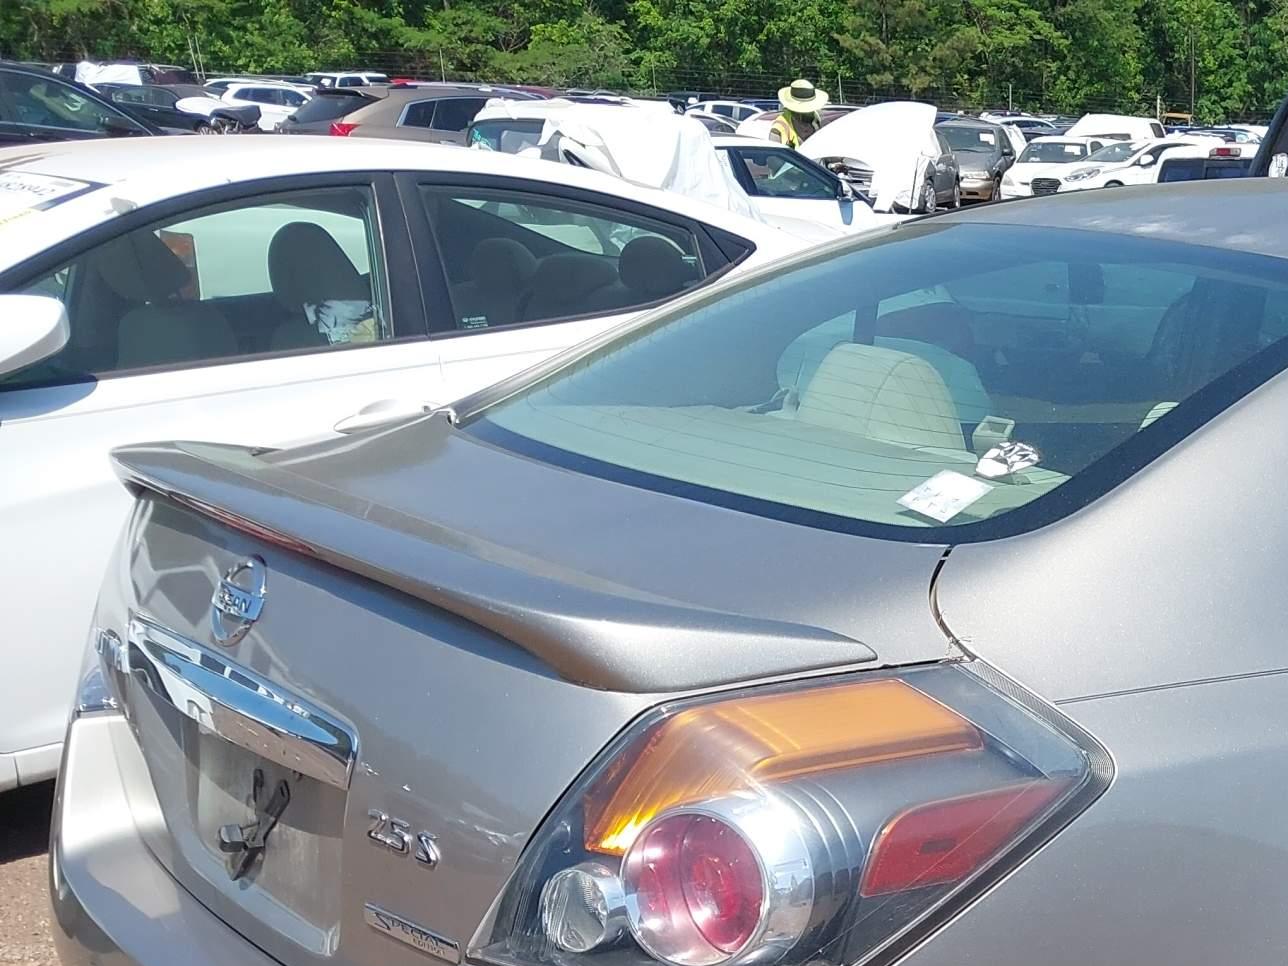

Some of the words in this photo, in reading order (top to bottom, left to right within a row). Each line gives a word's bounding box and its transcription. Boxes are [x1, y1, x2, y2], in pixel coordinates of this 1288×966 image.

[415, 831, 440, 865] S
[373, 911, 442, 948] SPECIAL
[412, 937, 446, 956] EDITION
